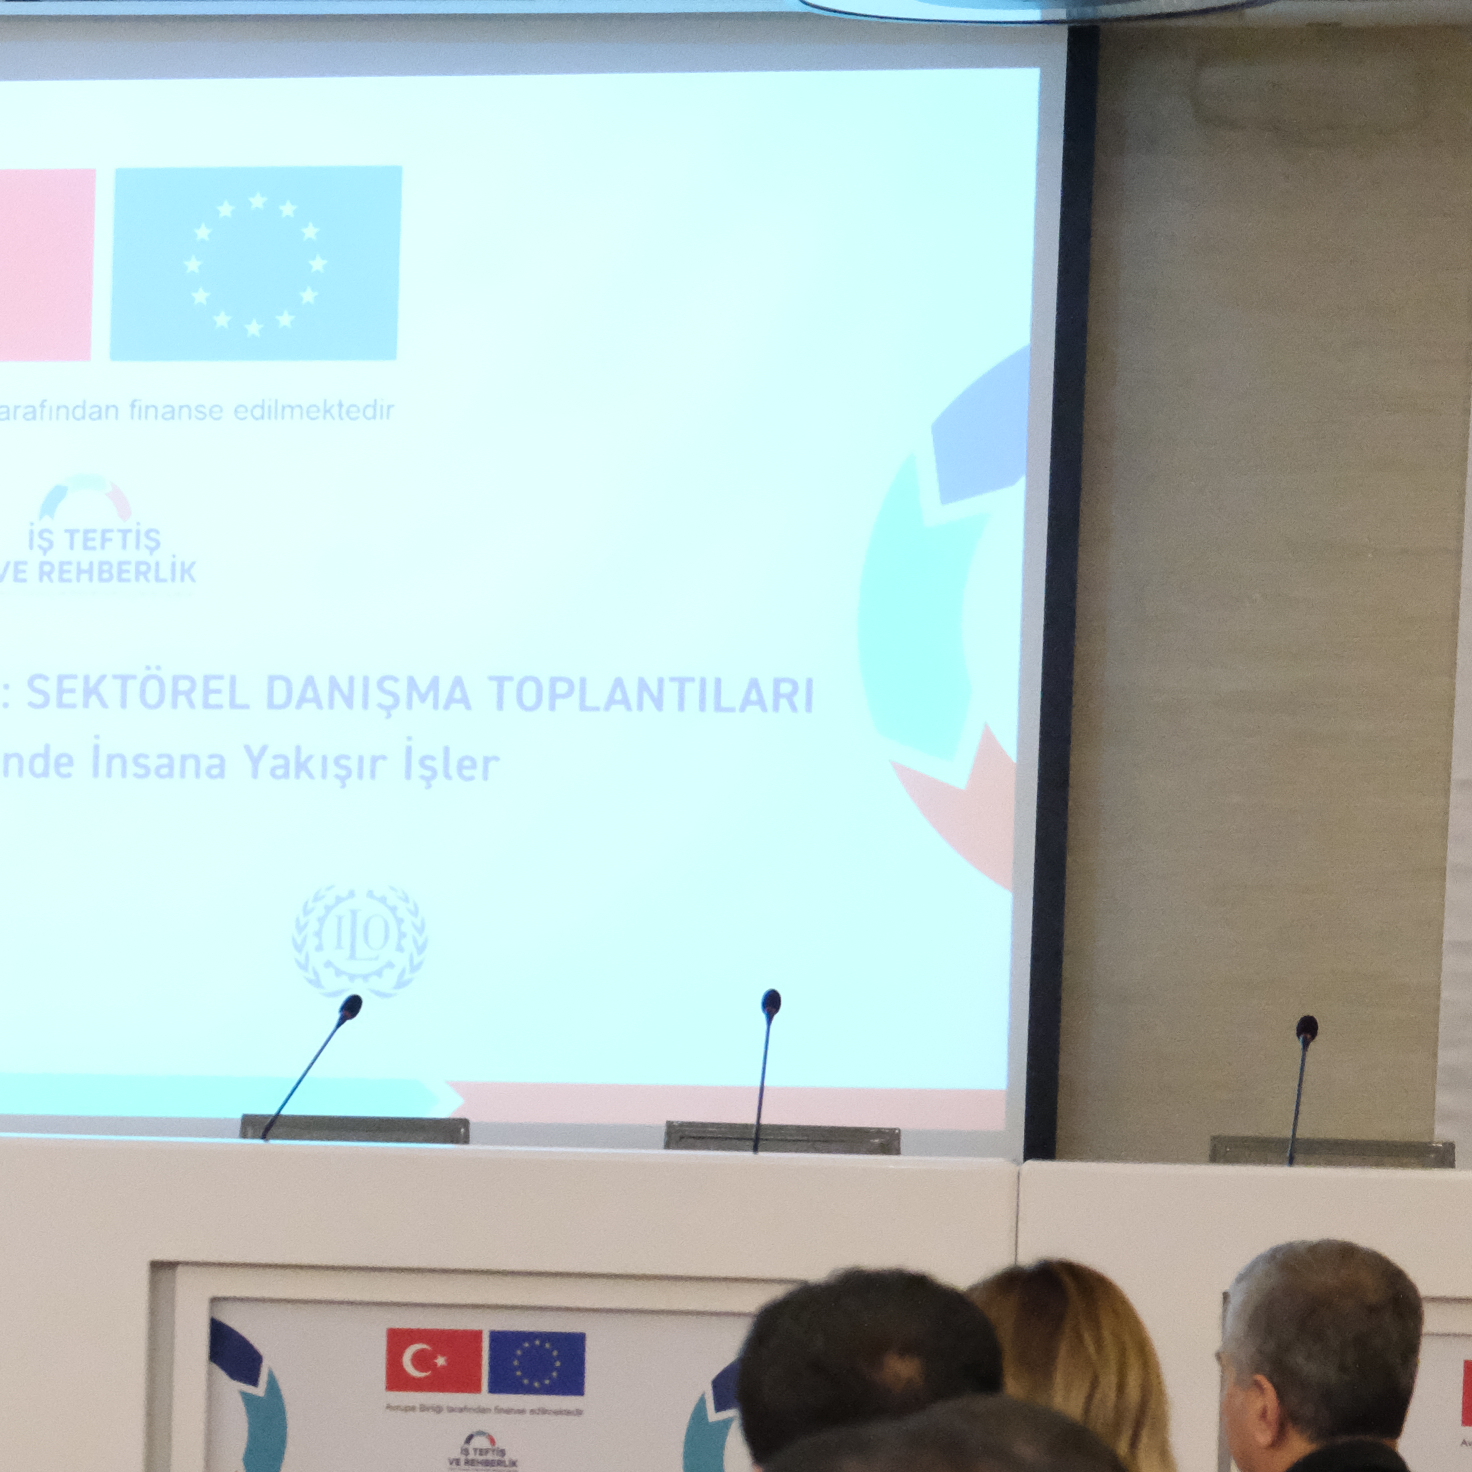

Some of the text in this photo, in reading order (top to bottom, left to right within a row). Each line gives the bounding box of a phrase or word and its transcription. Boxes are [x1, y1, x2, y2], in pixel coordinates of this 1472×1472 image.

[128, 397, 224, 422] finanse
[233, 398, 396, 422] edilmektedir
[28, 521, 162, 556] İŞ TEFTİŞ
[38, 553, 197, 584] REHBERLİK
[26, 664, 251, 711] SEKTÖREL
[266, 673, 473, 720] DANIŞMA
[487, 674, 815, 714] TOPLANTILARI
[91, 734, 227, 781] İnsana
[243, 743, 389, 790] Yakışır
[404, 735, 502, 790] İşler
[335, 909, 390, 961] ILO
